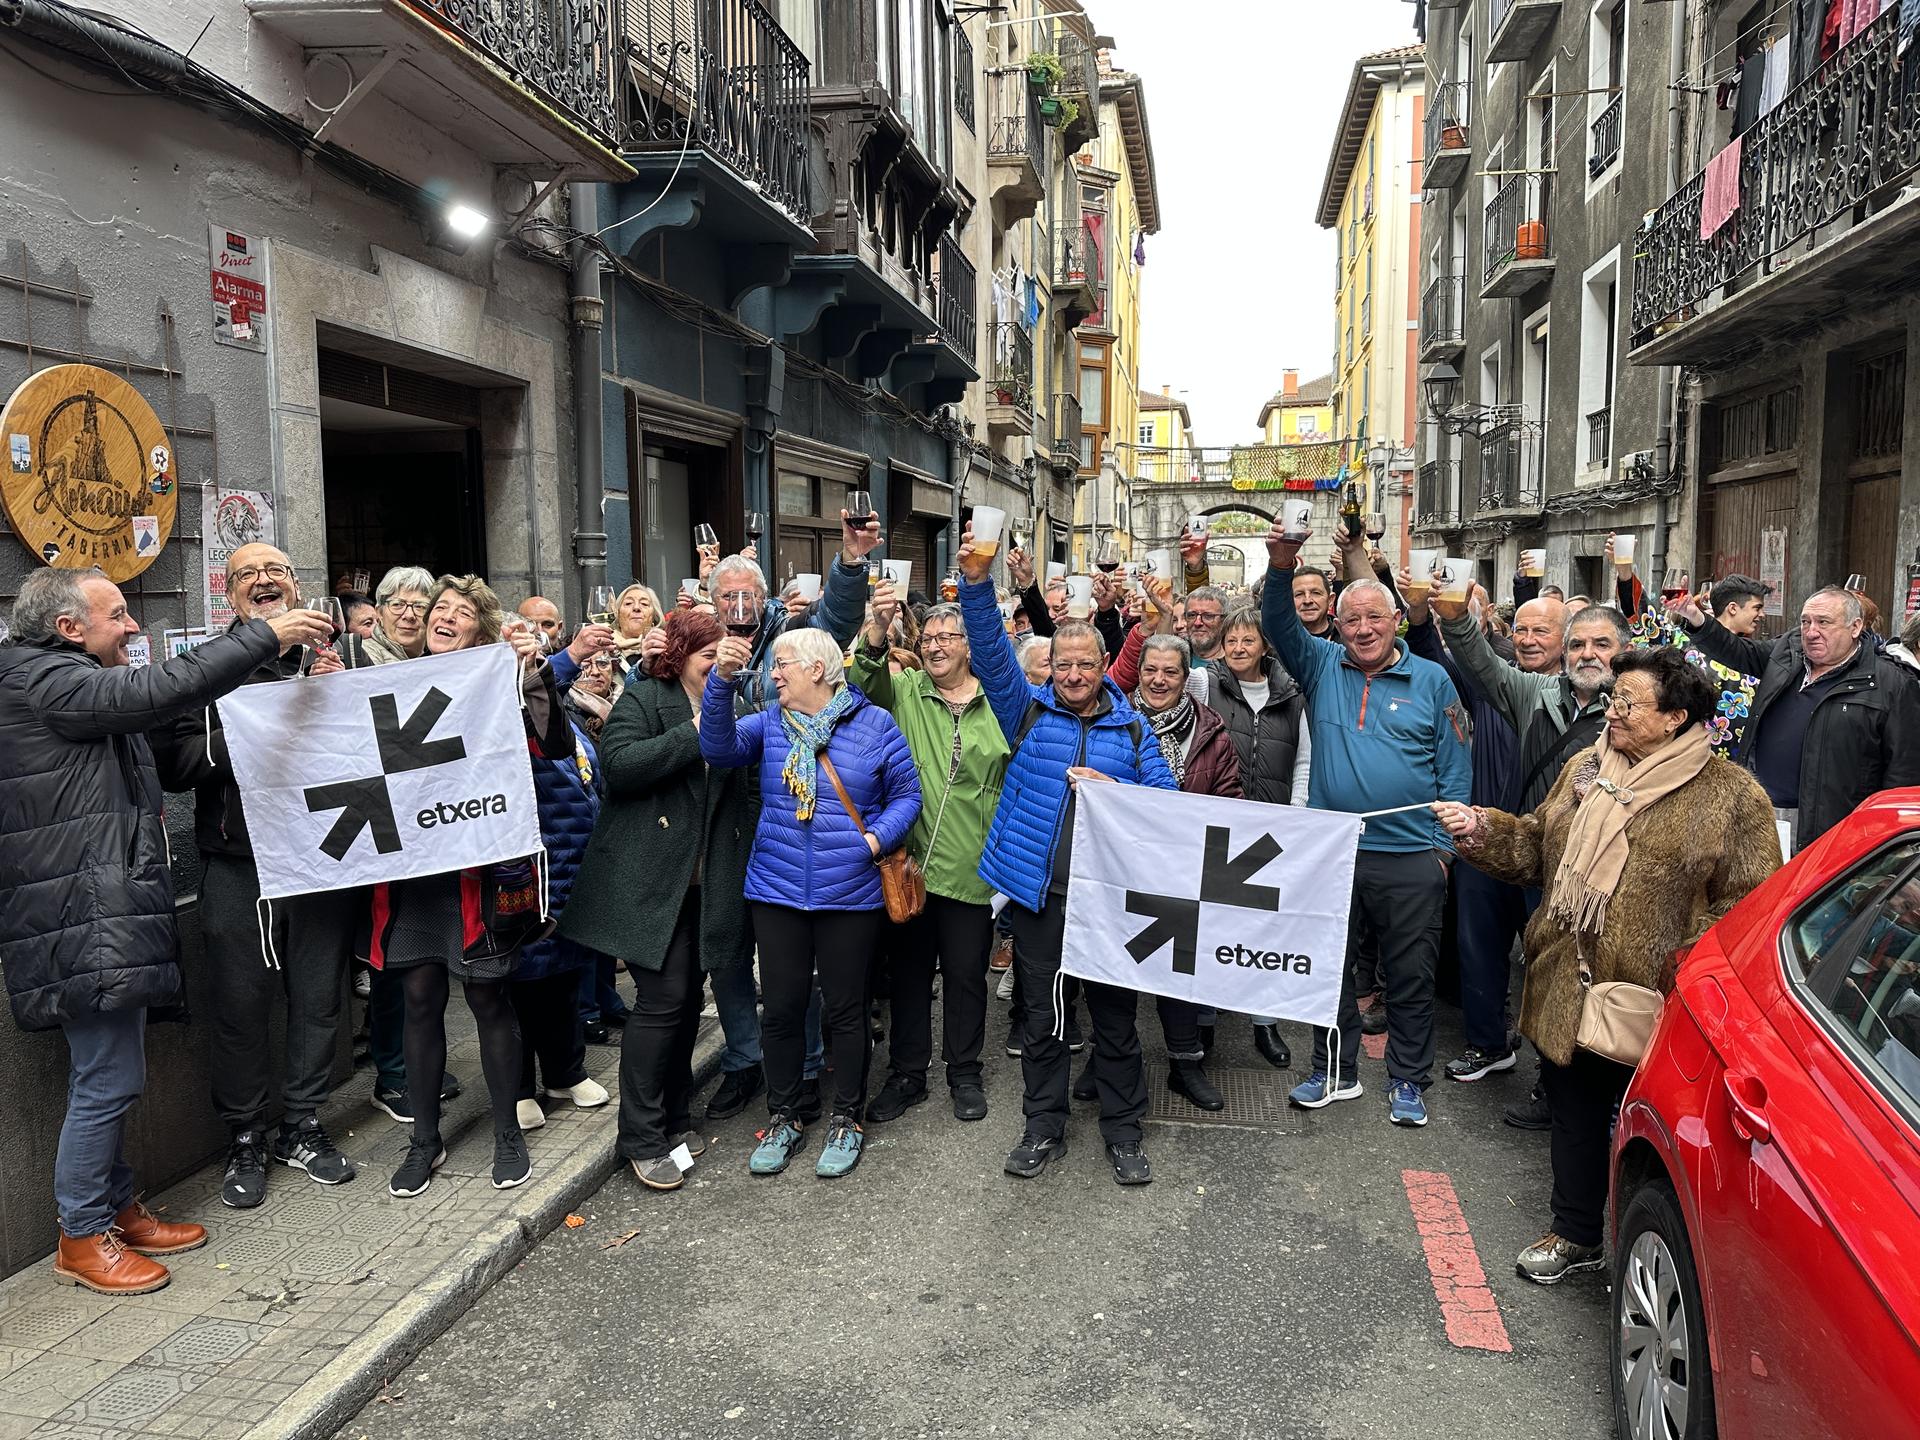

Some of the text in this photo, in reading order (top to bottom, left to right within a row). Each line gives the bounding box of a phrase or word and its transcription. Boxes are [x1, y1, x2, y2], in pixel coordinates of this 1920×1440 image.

[219, 250, 256, 267] Direct
[215, 276, 263, 302] Alarma
[57, 523, 133, 560] TABERNA
[208, 549, 236, 562] LEGO
[129, 649, 146, 658] EZAS
[416, 793, 507, 829] etxera
[1215, 943, 1312, 976] etxera
